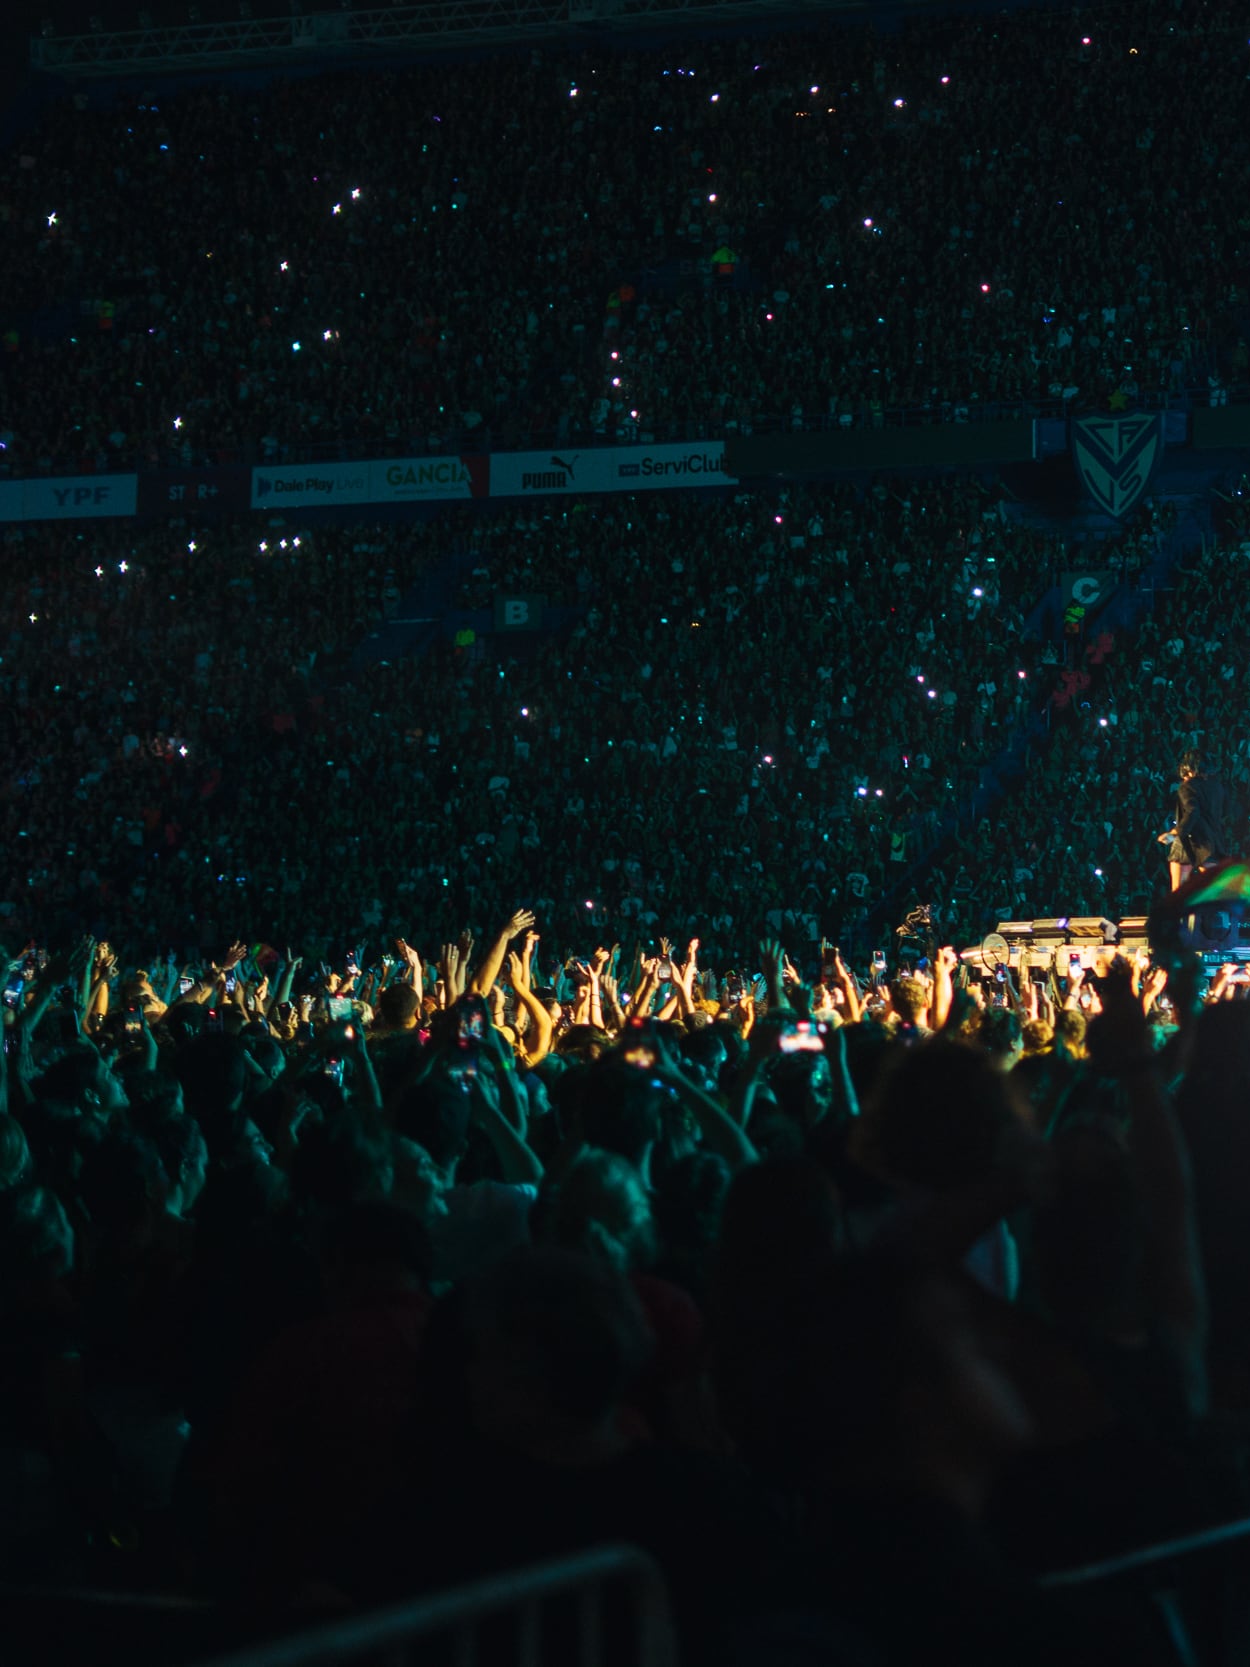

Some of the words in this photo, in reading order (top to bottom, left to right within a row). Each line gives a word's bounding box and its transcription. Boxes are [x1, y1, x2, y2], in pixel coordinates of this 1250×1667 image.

[274, 479, 302, 493] Dale
[305, 477, 335, 494] Play
[385, 462, 468, 487] GANCIA
[522, 471, 567, 489] PUMA
[52, 485, 113, 507] YPF
[167, 482, 219, 501] STR+
[1072, 577, 1100, 604] C
[505, 600, 529, 625] B
